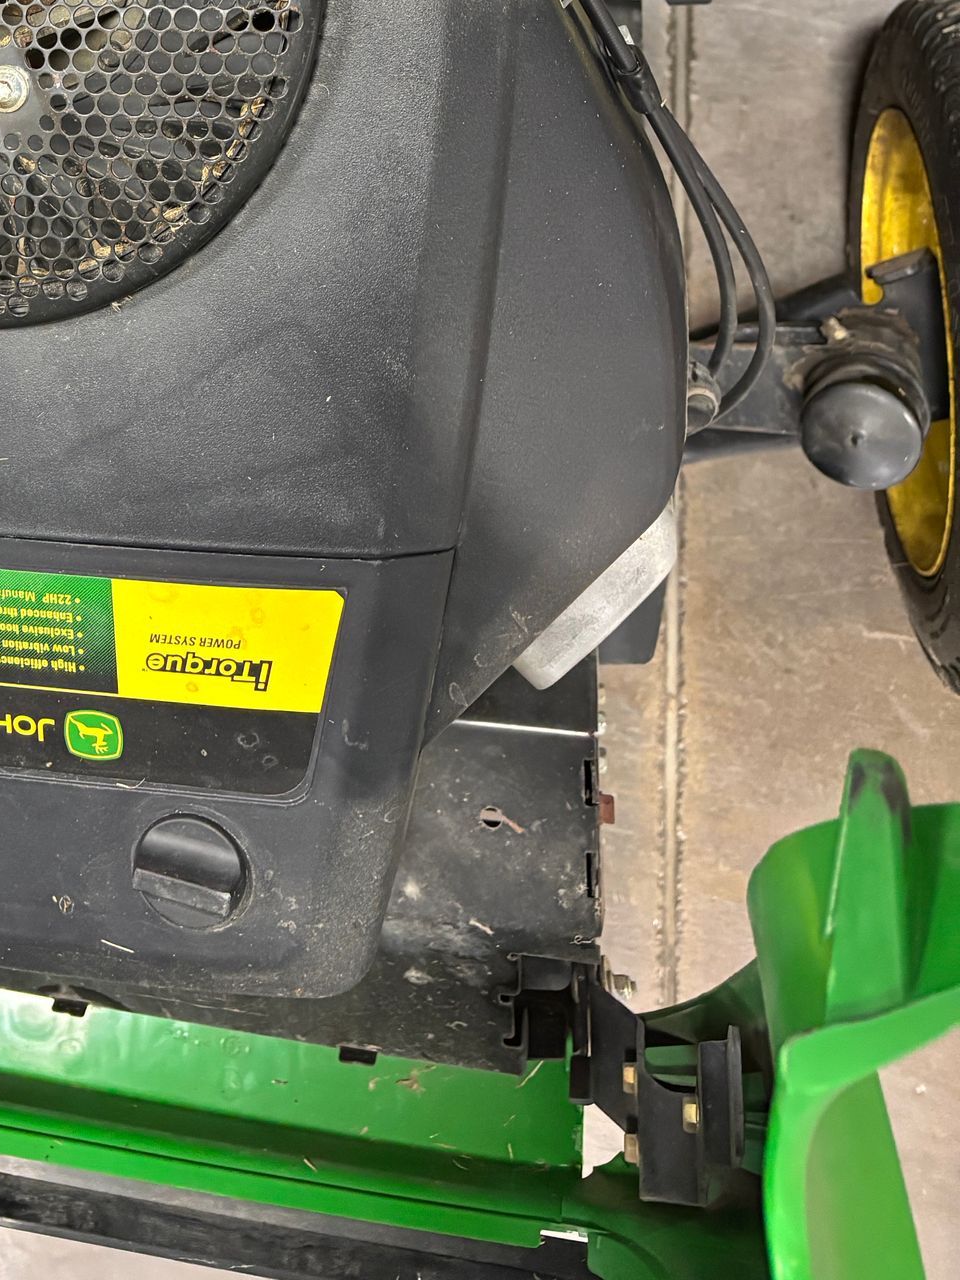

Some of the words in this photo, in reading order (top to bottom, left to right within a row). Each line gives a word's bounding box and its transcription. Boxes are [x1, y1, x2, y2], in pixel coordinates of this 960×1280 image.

[42, 593, 71, 605] 22HP
[20, 608, 73, 623] Enhanced
[22, 625, 74, 639] Exclusive
[150, 634, 196, 646] SYSTEM
[200, 638, 241, 649] POWER
[2, 640, 50, 653] vibration
[53, 644, 75, 655] Low
[51, 659, 76, 672] High
